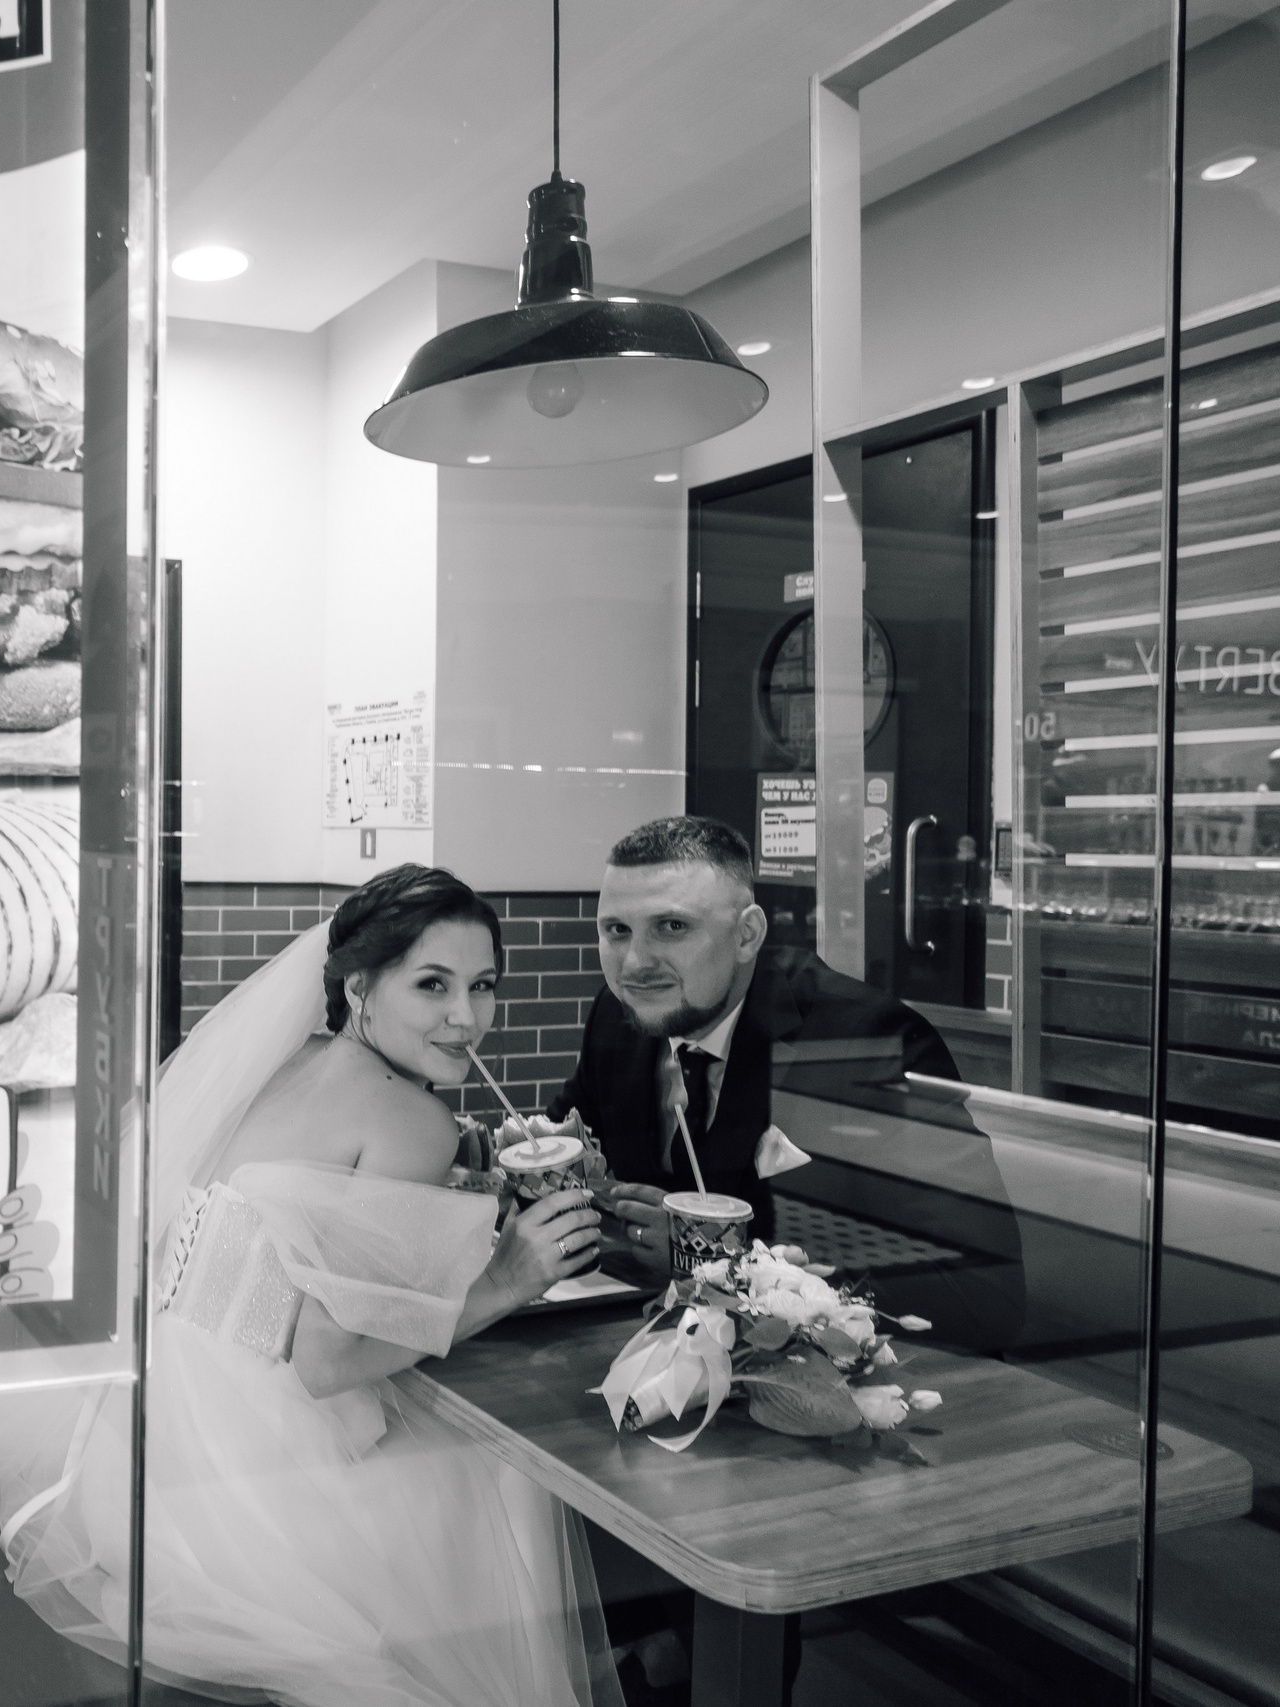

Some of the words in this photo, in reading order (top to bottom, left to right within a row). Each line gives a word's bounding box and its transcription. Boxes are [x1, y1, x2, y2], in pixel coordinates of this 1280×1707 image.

[762, 779, 801, 790] ХОЧЕШЬ
[762, 791, 781, 801] ЧЕМ
[791, 791, 811, 801] НАС
